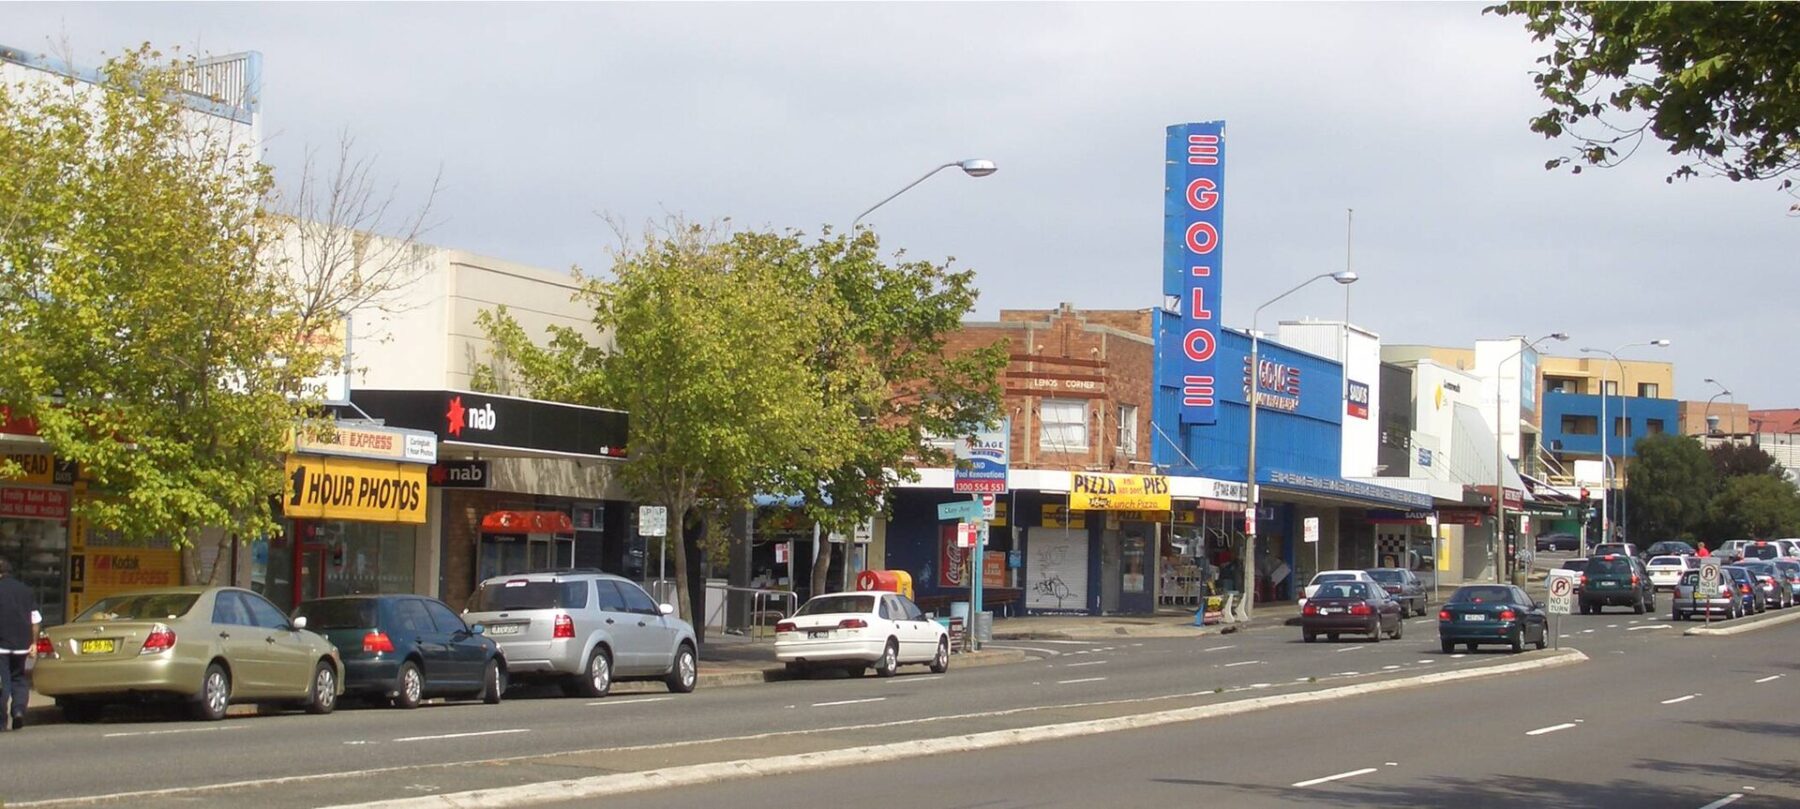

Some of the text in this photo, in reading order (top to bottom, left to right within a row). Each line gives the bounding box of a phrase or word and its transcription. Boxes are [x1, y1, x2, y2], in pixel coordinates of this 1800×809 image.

[1184, 177, 1219, 362] GO-LO
[1065, 380, 1095, 389] CORNER
[468, 403, 496, 431] nab
[350, 431, 393, 450] EXPRESS
[450, 465, 482, 481] nab
[969, 470, 1005, 479] Renovations
[289, 466, 421, 511] 1 HOUR PHOTOS
[956, 483, 1004, 491] 1300 554 551
[1074, 474, 1168, 495] PIZZA PIES
[112, 554, 138, 569] Kodak
